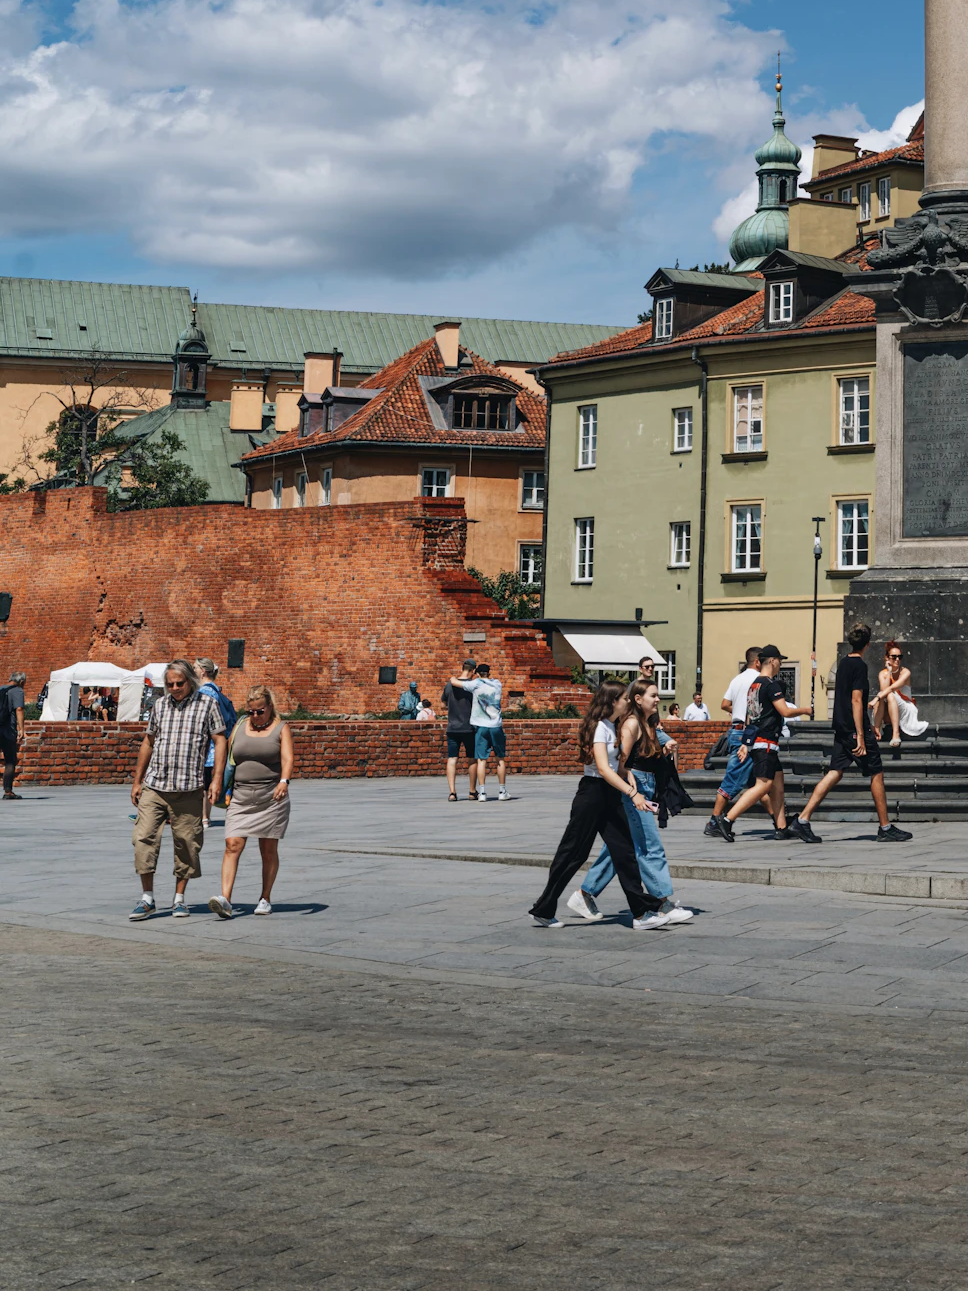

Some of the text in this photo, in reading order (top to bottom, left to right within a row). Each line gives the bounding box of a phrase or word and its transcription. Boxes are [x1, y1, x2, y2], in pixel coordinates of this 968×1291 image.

[927, 407, 959, 416] FILIVS
[926, 441, 961, 450] GRATVS
[912, 453, 936, 461] PATRI
[909, 499, 936, 507] GLORIA
